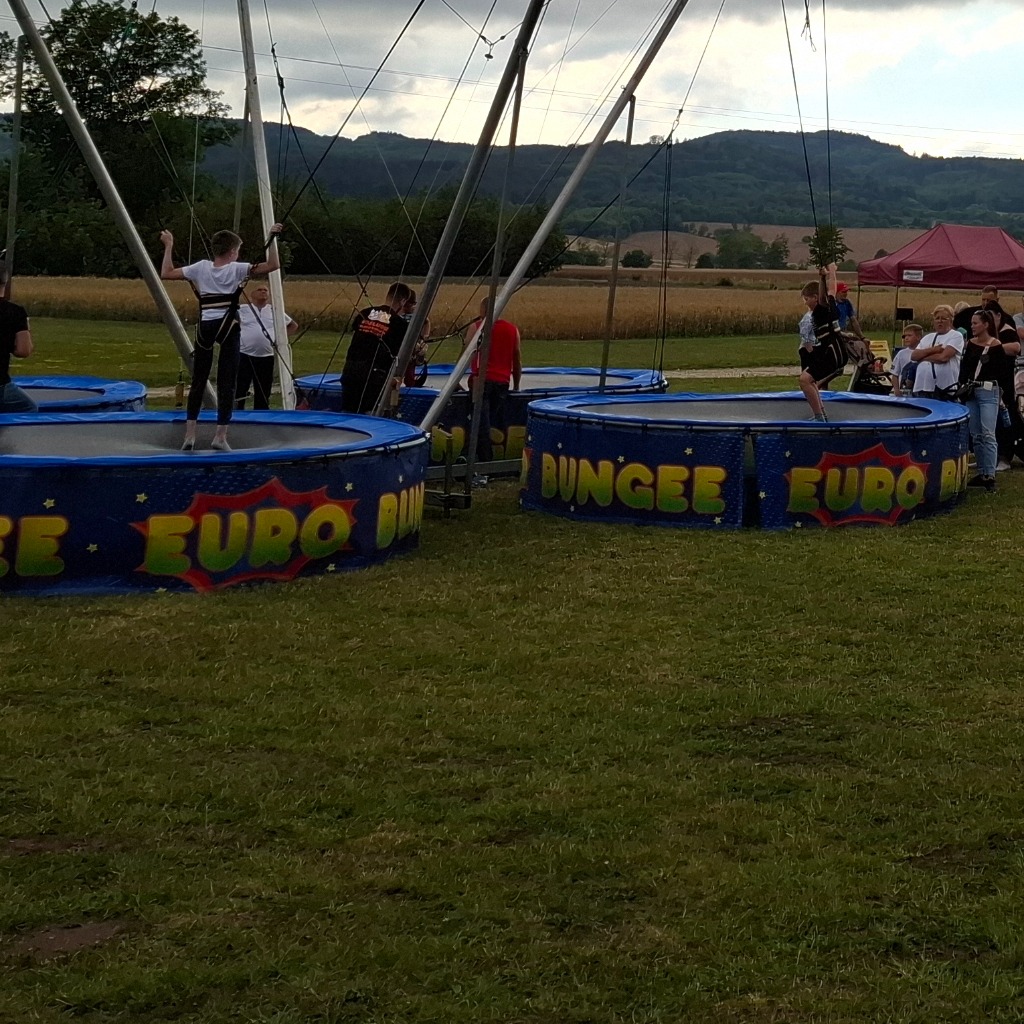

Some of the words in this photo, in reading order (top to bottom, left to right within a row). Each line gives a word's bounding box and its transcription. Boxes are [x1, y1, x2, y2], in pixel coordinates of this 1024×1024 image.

[541, 452, 728, 515] BUNGEE
[786, 466, 926, 513] EURO
[145, 502, 352, 576] EURO
